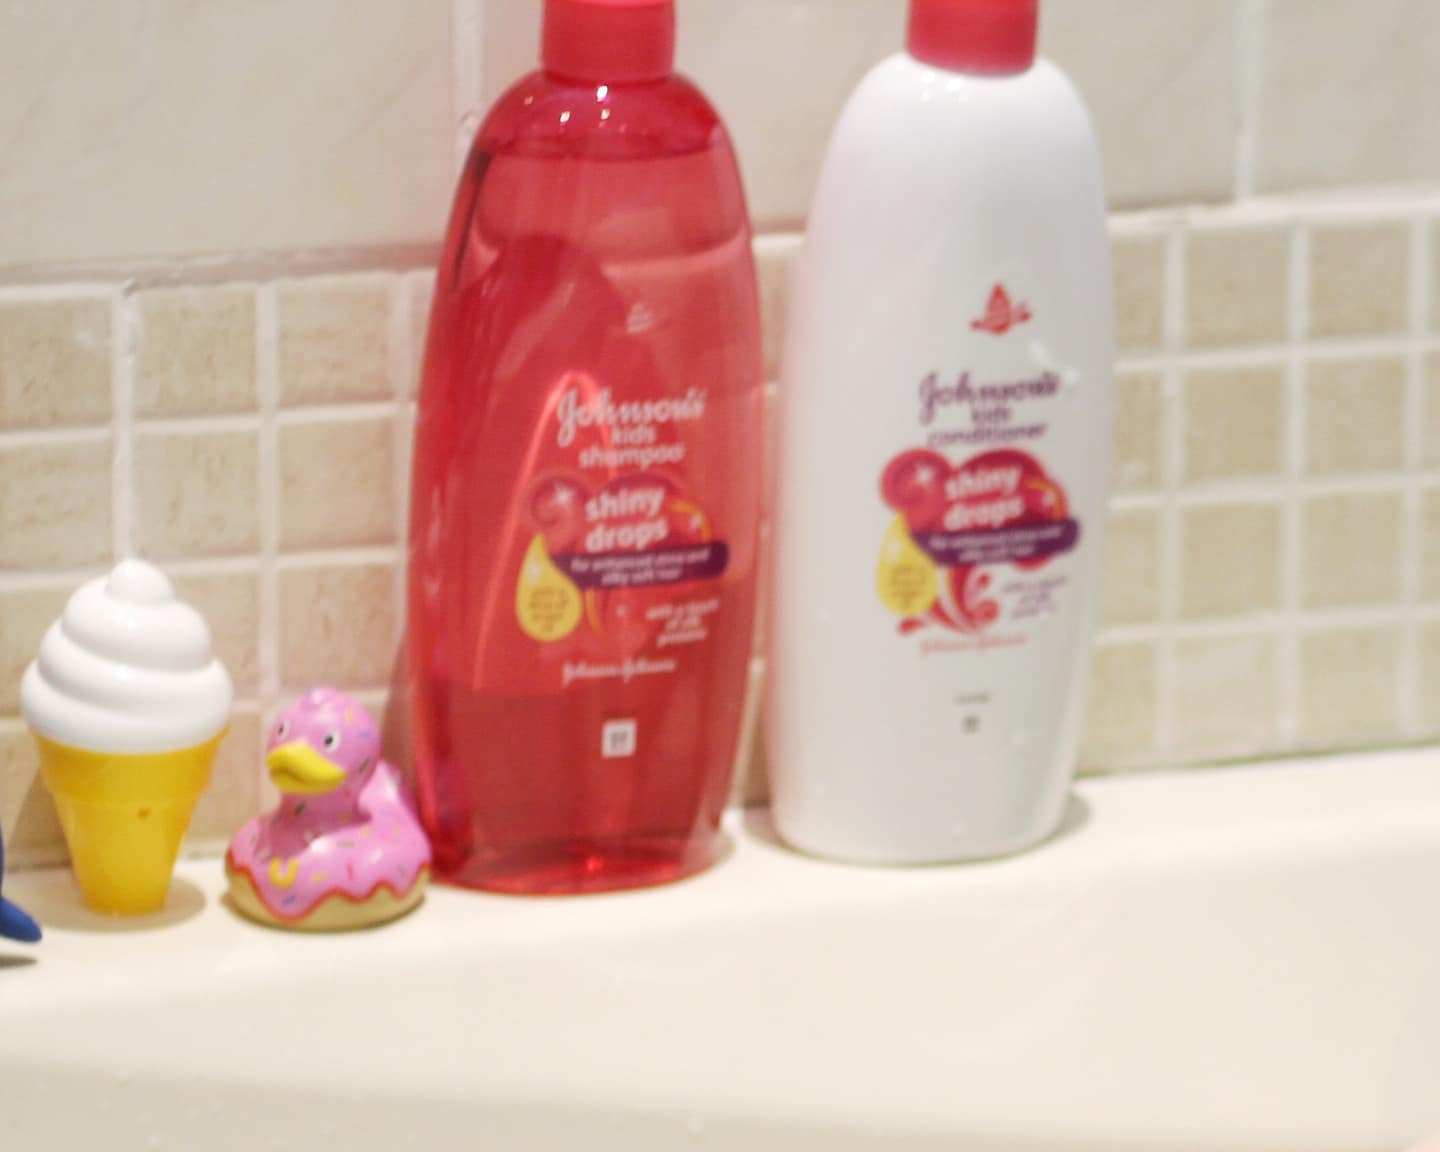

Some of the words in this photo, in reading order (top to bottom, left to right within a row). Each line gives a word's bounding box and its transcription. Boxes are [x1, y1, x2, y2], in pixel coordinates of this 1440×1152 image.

[557, 386, 707, 448] Johnson's
[612, 423, 657, 445] kids
[926, 423, 1047, 446] conditioner
[579, 442, 686, 470] shampoo
[945, 466, 1023, 500] shiny
[586, 488, 665, 522] shiny
[944, 498, 1025, 531] drops
[586, 517, 668, 552] drops
